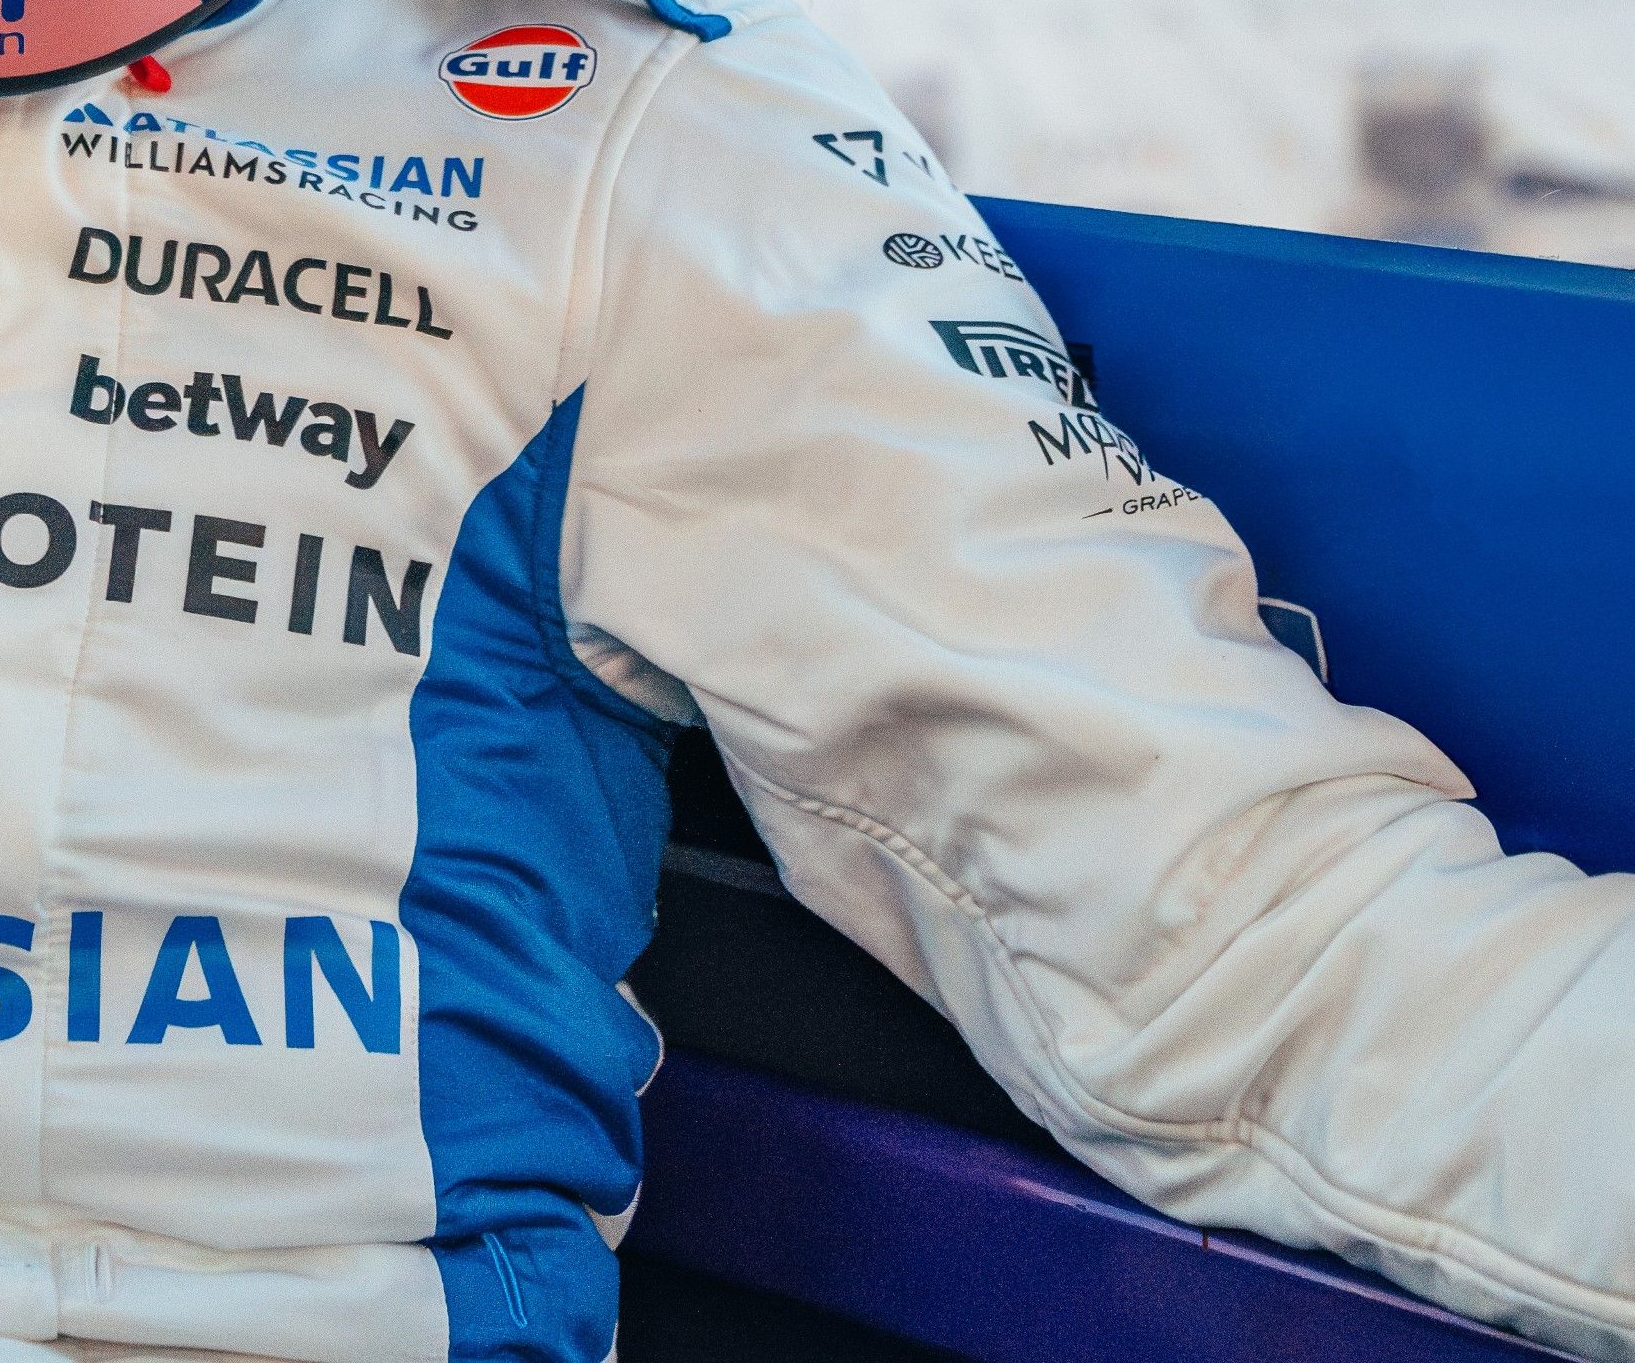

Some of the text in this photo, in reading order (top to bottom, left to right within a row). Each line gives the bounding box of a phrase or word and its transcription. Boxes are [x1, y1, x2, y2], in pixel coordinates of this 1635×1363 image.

[446, 48, 591, 82] Gulf
[60, 131, 479, 233] WILLIAMS RACING
[122, 111, 485, 199] ATLASSIAN
[67, 225, 454, 341] DURACELL
[939, 234, 1024, 283] KEE
[69, 353, 416, 490] betway
